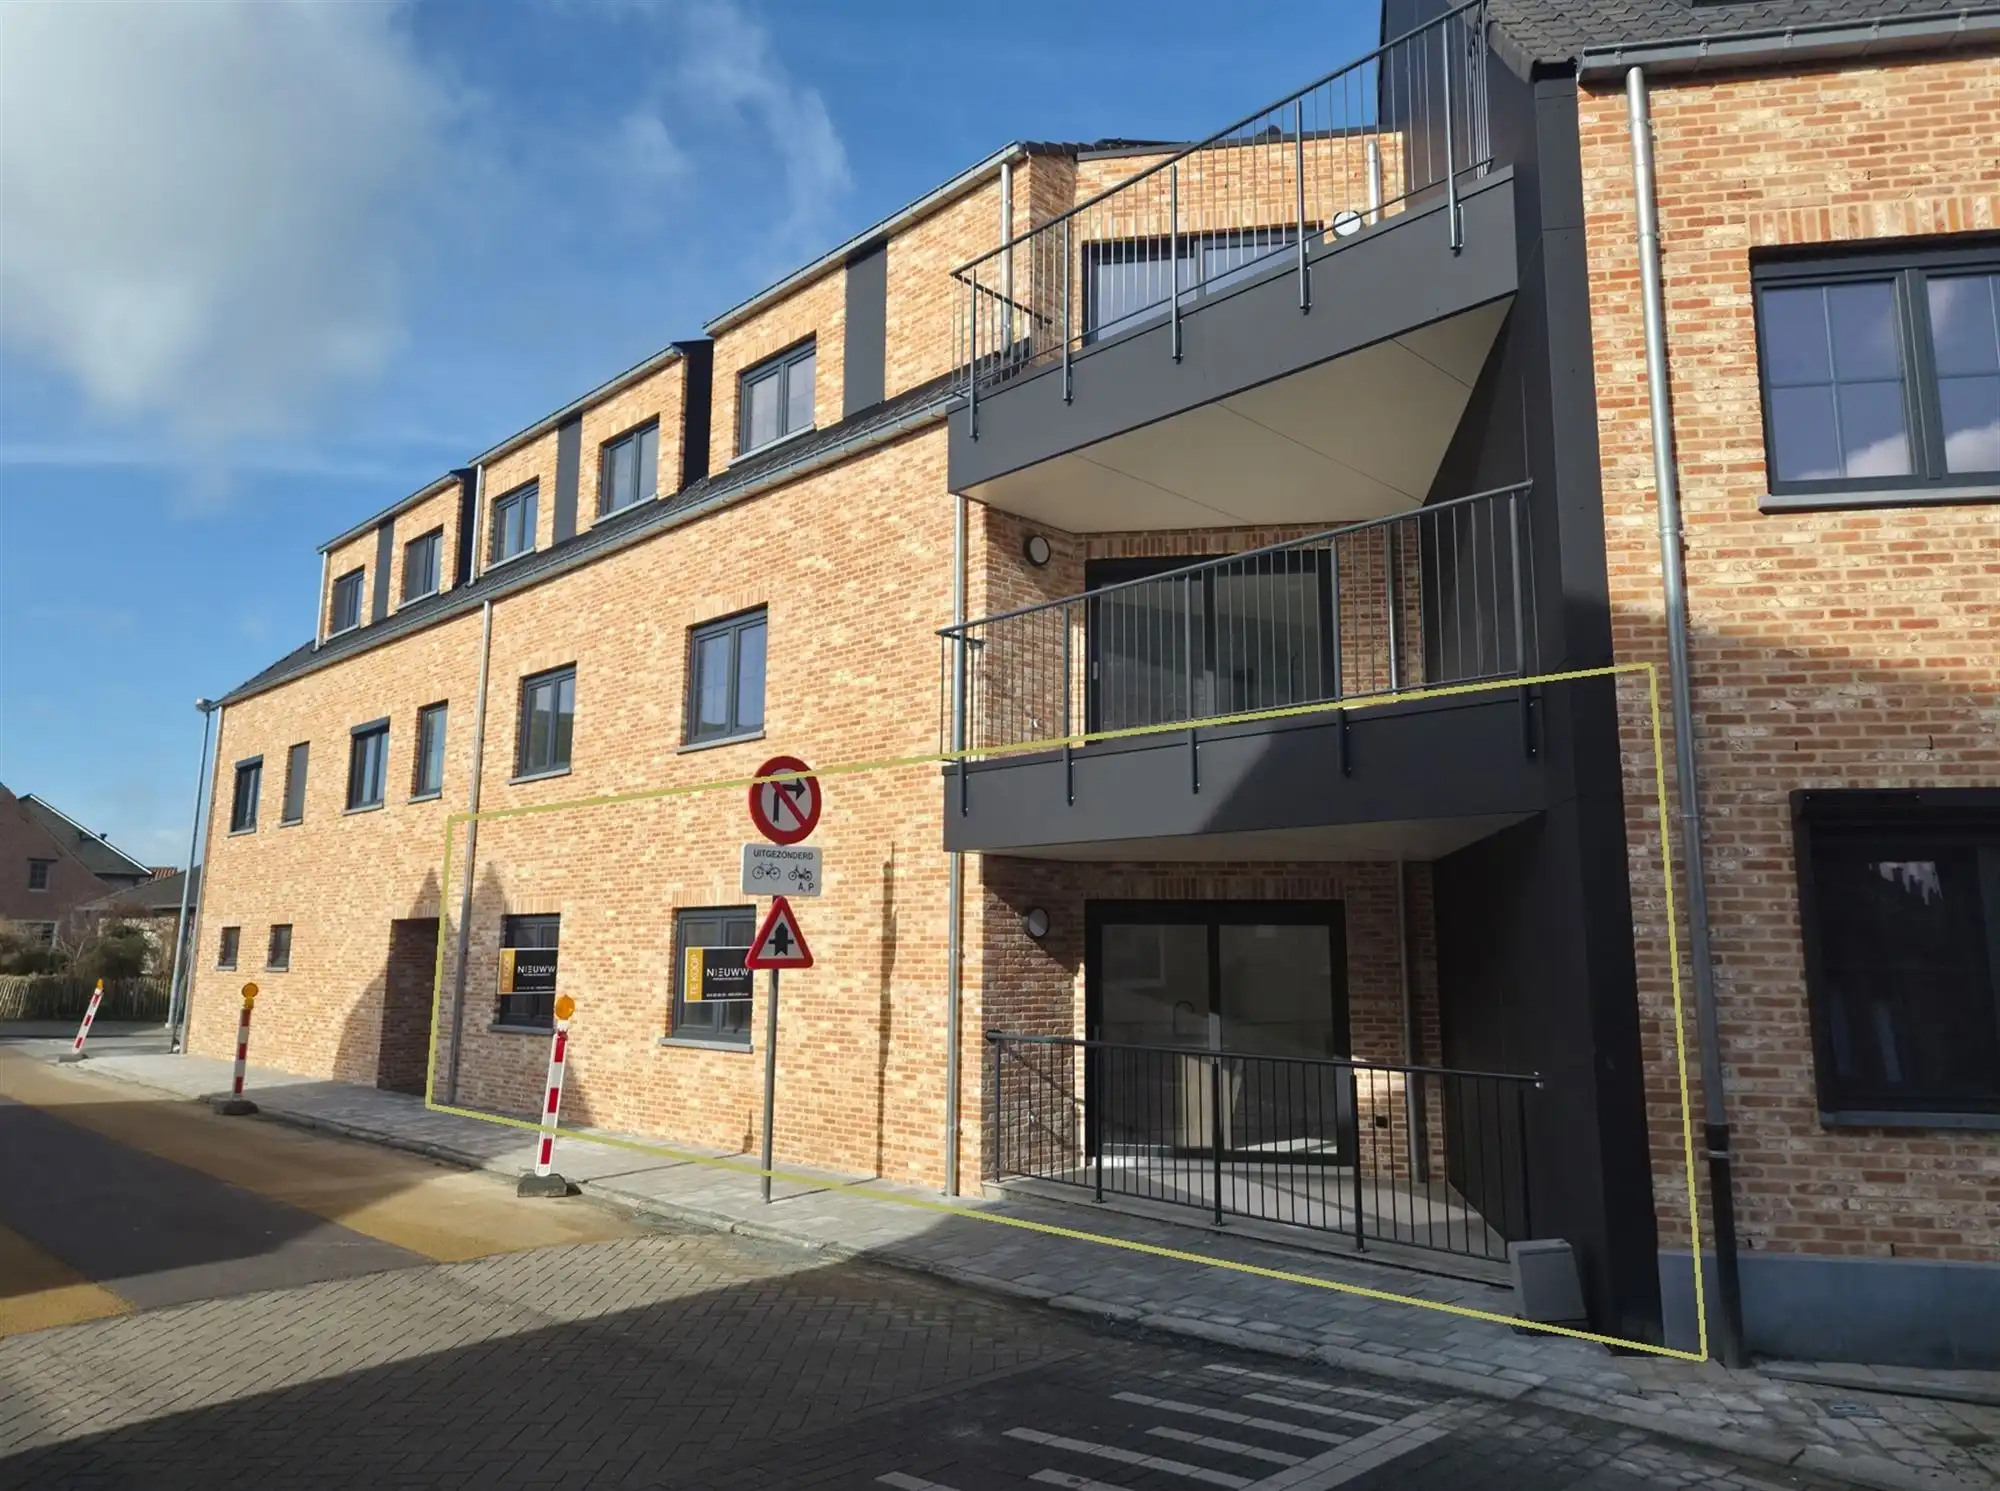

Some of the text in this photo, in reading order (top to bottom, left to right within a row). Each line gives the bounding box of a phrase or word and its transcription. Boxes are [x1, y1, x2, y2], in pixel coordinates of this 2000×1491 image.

[752, 848, 815, 861] UITGEZONDERD
[808, 882, 815, 892] P
[690, 954, 700, 995] TE KOOP
